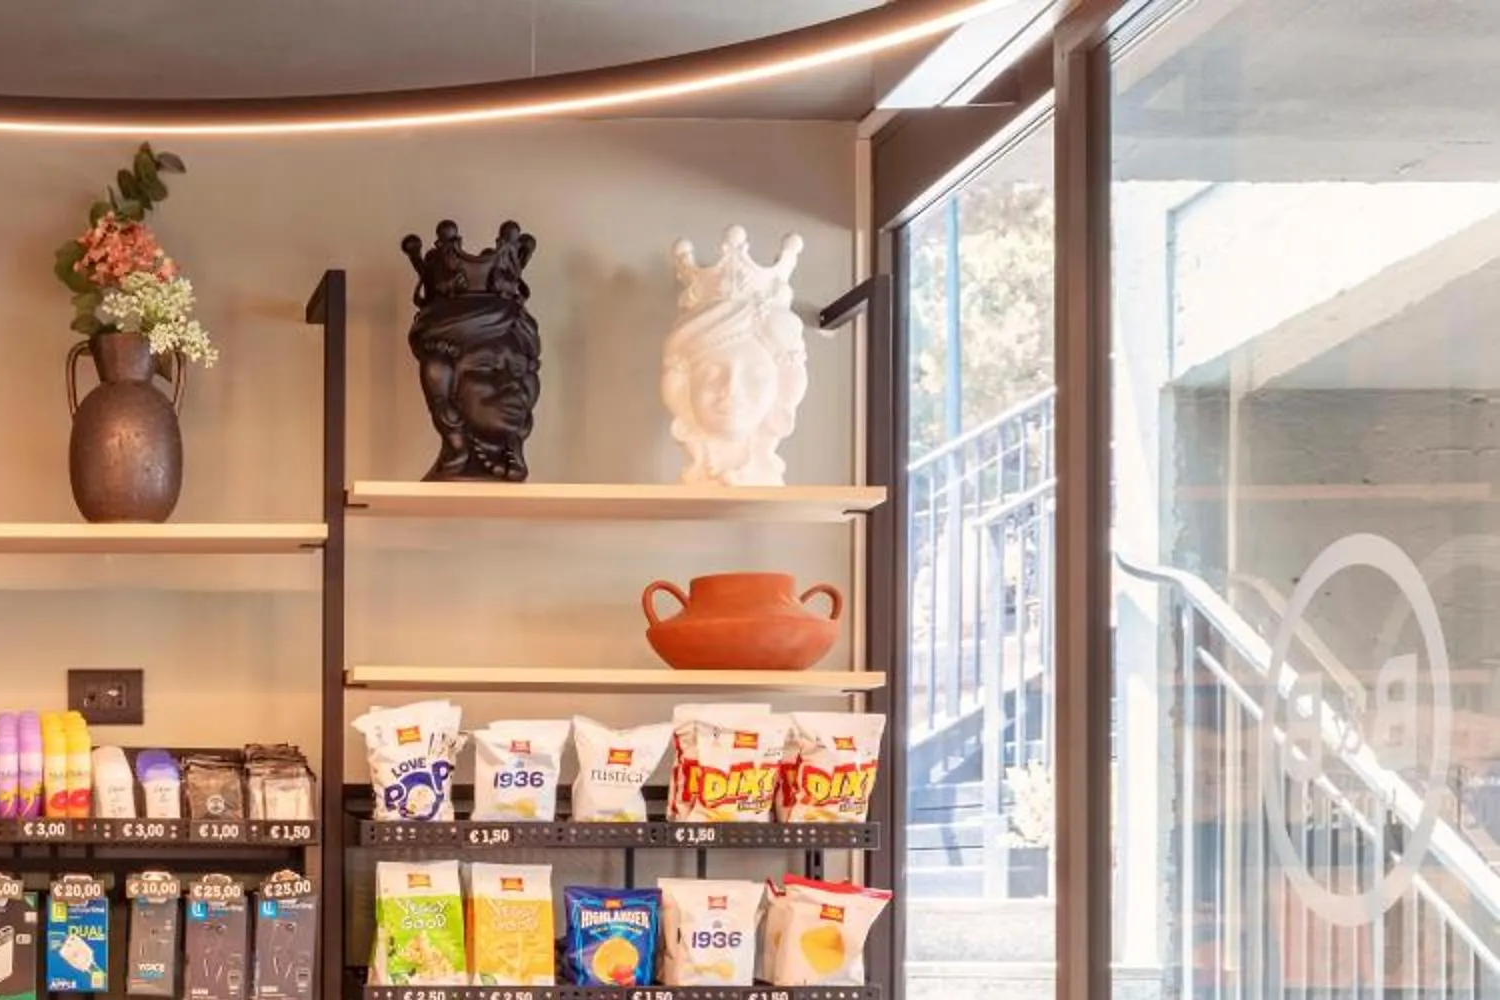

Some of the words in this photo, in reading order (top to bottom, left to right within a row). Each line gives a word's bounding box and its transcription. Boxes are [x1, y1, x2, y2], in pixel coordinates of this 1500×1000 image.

[391, 757, 428, 779] LOVE
[591, 766, 644, 784] rustica
[493, 771, 545, 788] 1936
[68, 925, 105, 937] DUAL
[691, 931, 742, 949] 1936
